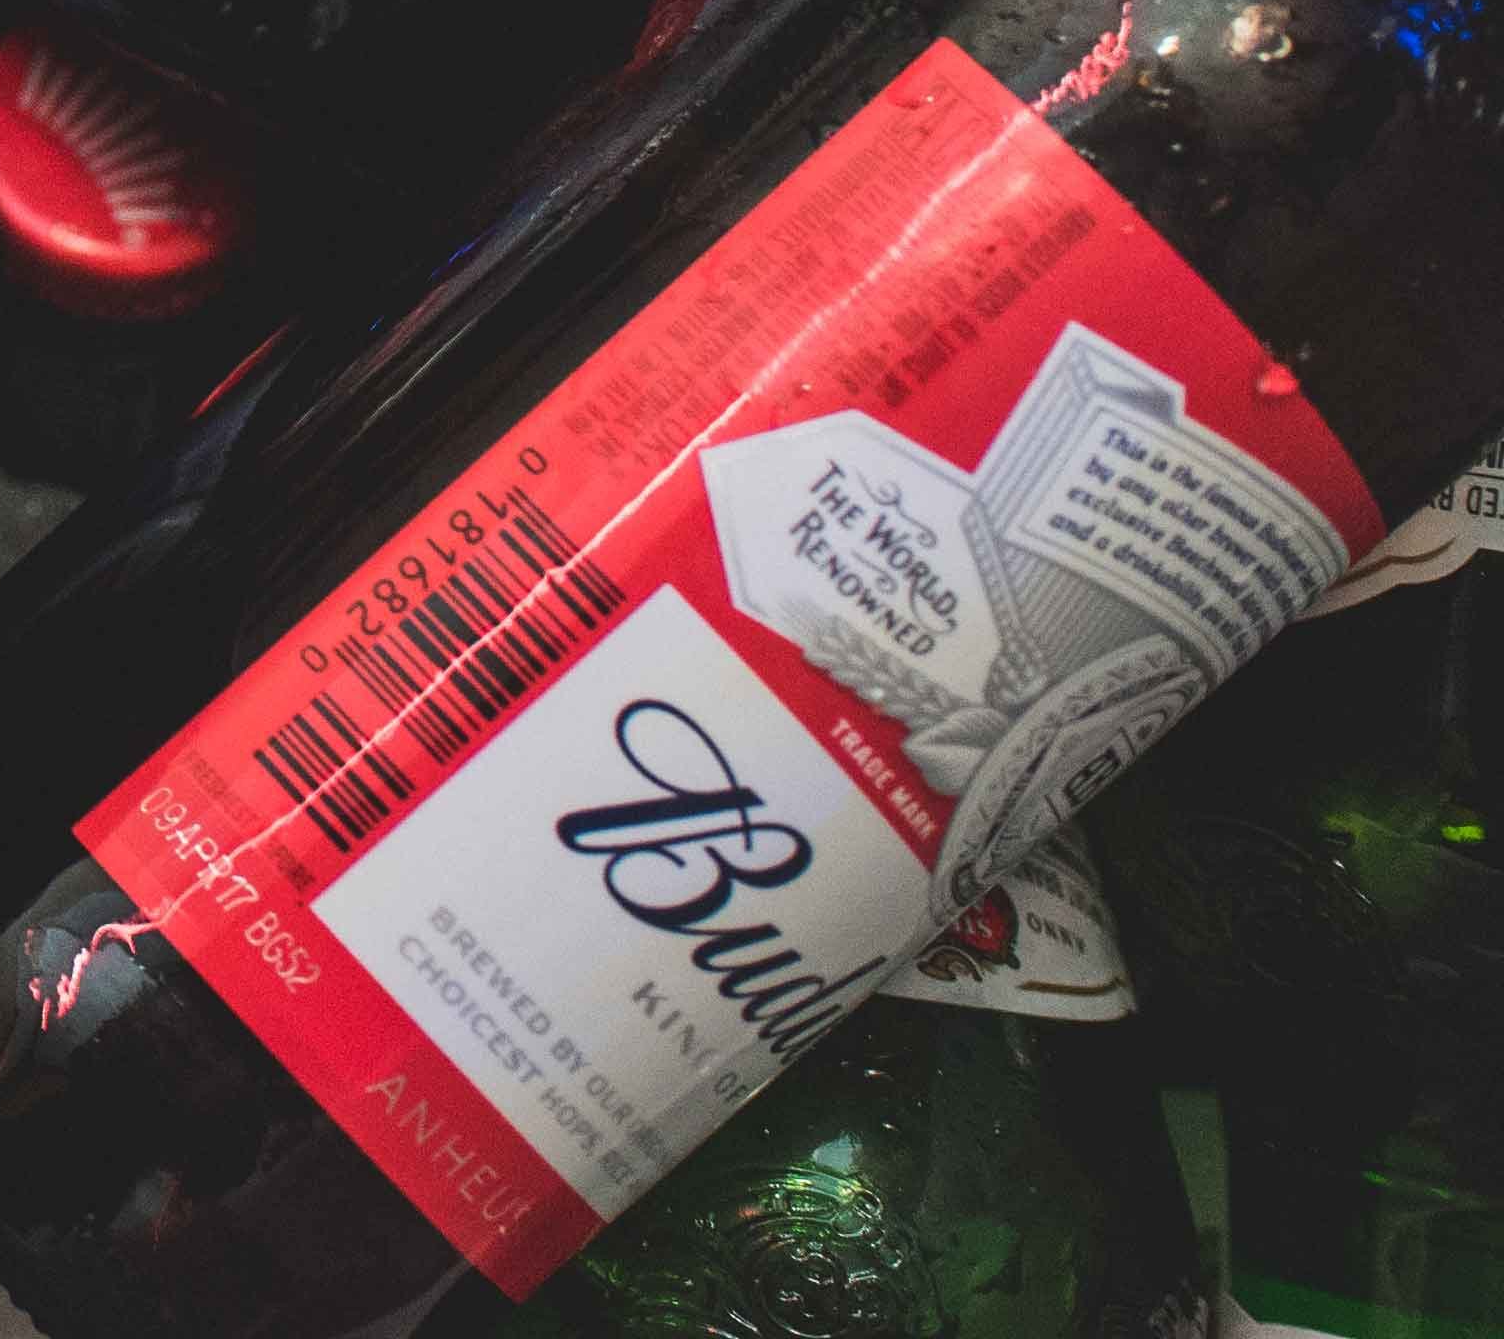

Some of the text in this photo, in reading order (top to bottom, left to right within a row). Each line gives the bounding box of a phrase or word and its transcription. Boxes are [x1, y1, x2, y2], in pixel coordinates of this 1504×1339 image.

[808, 458, 868, 535] THE
[788, 508, 936, 659] RENOWNED
[826, 717, 938, 844] TRADE MARK
[140, 786, 260, 913] 09APR17
[243, 911, 321, 995] BG52
[398, 934, 545, 1085] CHOICEST
[428, 905, 589, 1076] BREWED BY
